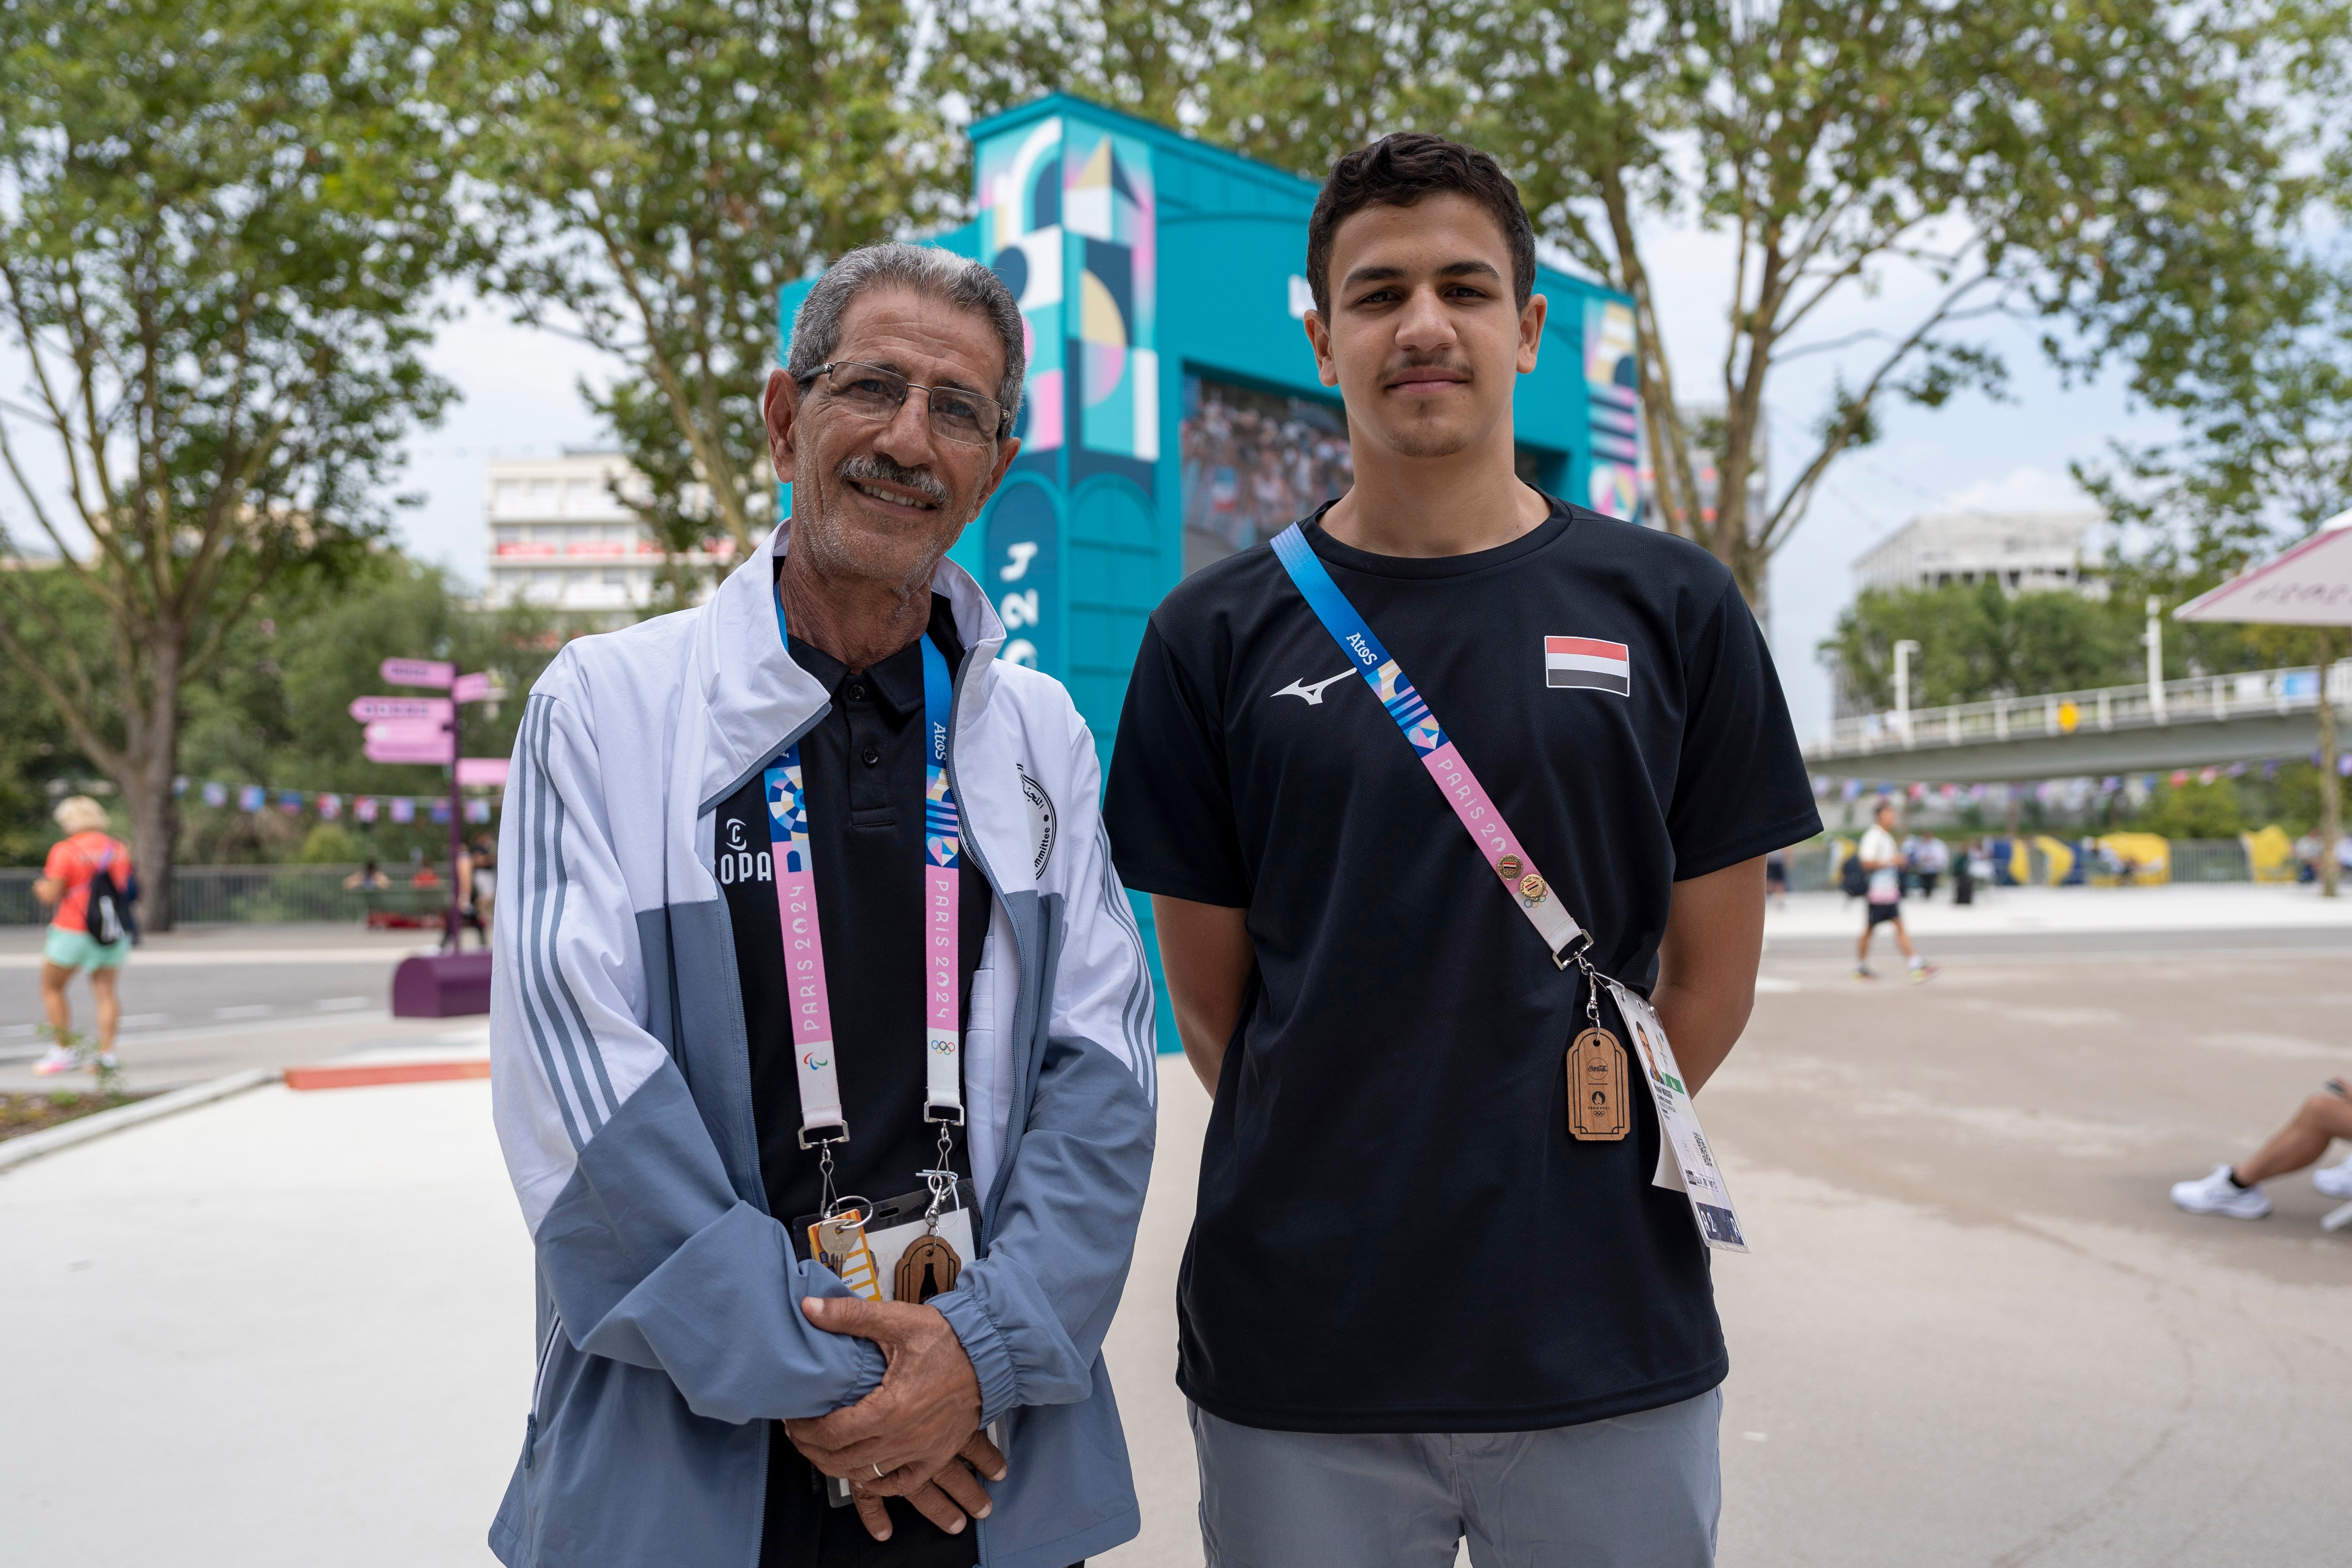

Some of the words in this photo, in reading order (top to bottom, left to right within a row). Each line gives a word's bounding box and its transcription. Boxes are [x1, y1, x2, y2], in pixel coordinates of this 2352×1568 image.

[1346, 632, 1378, 665] Atos
[934, 721, 947, 760] Atos
[1034, 827, 1050, 868] mmittee
[715, 852, 772, 884] OPA
[789, 886, 811, 950] 2024
[936, 956, 949, 1018] 2024
